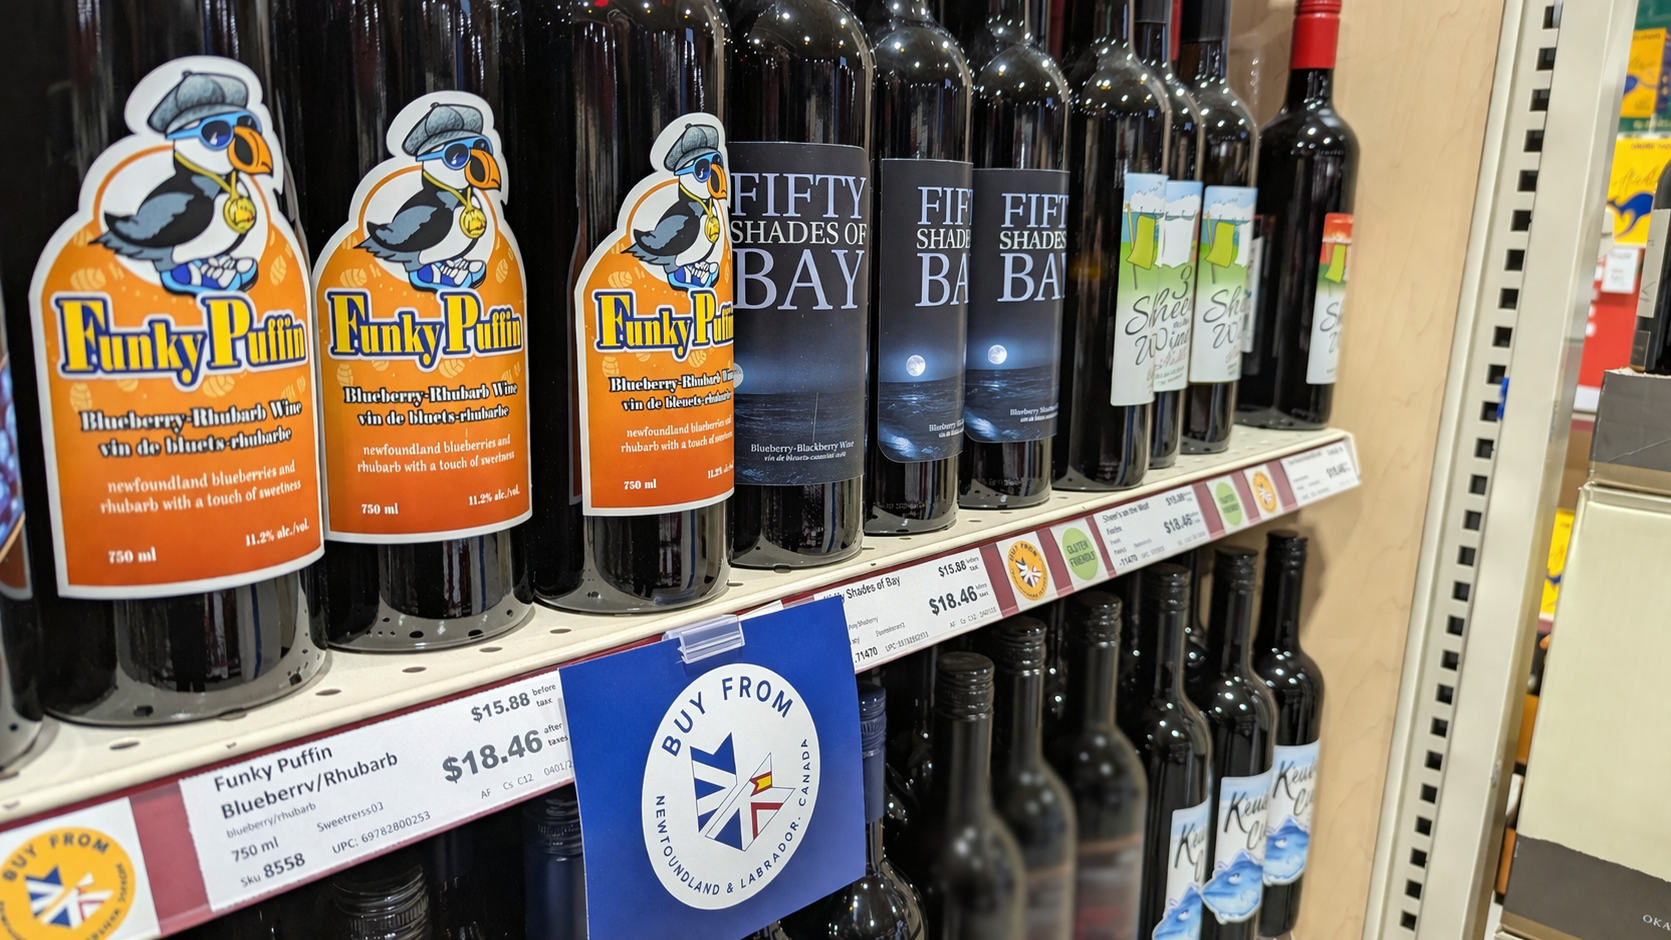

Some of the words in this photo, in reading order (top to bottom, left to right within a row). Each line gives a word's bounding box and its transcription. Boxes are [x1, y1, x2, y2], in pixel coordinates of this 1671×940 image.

[730, 172, 867, 219] FIFTY
[729, 220, 839, 246] SHADES
[844, 221, 868, 246] OF
[999, 230, 1067, 250] SHADES
[732, 249, 866, 311] BAY
[328, 291, 444, 369] Funky
[439, 292, 522, 354] Puffin
[595, 292, 693, 358] Funky
[55, 297, 207, 384] Funky
[199, 295, 306, 370] Puffin
[343, 383, 490, 408] Blueberry-Rhubarb
[491, 380, 518, 397] Wine
[609, 373, 721, 393] Blueberry-Rhubarb
[79, 403, 267, 435] Blueberry-Rhubarb
[268, 398, 303, 420] Wine
[621, 398, 644, 411] vin
[646, 397, 663, 411] de
[357, 410, 383, 426] vin
[386, 410, 405, 426] de
[626, 423, 689, 438] newfoundland
[98, 437, 131, 457] vin
[136, 438, 161, 456] de
[363, 442, 441, 456] newfoundland
[443, 437, 496, 453] blueberries
[497, 433, 511, 446] and
[621, 441, 659, 453] rhubarb
[661, 439, 679, 451] with
[681, 441, 687, 449] a
[688, 435, 707, 448] touch
[107, 473, 208, 493] newfoundland
[211, 466, 277, 486] blueberries
[279, 459, 296, 475] and
[357, 460, 401, 473] rhubarb
[404, 460, 427, 472] with
[430, 462, 437, 471] a
[439, 456, 467, 470] touch
[470, 455, 479, 467] of
[100, 497, 159, 514] rhubarb
[162, 495, 191, 511] with
[195, 497, 204, 508] a
[207, 489, 243, 506] touch
[245, 486, 258, 501] of
[259, 480, 302, 499] sweetness
[624, 480, 642, 490] 750
[644, 478, 657, 489] ml
[361, 504, 381, 515] 750
[384, 503, 399, 515] ml
[468, 493, 492, 506] 11.2%
[245, 530, 275, 547] 11.2%
[277, 517, 310, 540] alc./vol.
[108, 549, 134, 564] 750
[138, 546, 157, 562] ml
[938, 560, 967, 578] $15.88
[846, 583, 876, 599] Shades
[876, 580, 886, 591] of
[886, 575, 901, 589] Bay
[929, 585, 978, 616] $18.46
[471, 692, 531, 723] $15.88
[531, 684, 557, 697] before
[661, 690, 706, 757] BUY
[721, 675, 793, 718] FROM
[442, 729, 543, 784] $18.46
[543, 722, 563, 734] after
[547, 734, 570, 747] taxes
[213, 765, 272, 792] Funky
[277, 746, 333, 773] Puffin
[481, 788, 492, 799] AF
[502, 781, 514, 791] Cs
[517, 773, 534, 786] C12
[226, 802, 317, 839] blueberry/rhubarb
[726, 882, 735, 894] &
[798, 739, 812, 807] CANADA
[332, 838, 359, 854] UPC:
[361, 810, 431, 844] 69782800253
[2, 844, 37, 882] BUY
[49, 832, 110, 855] FROM
[231, 845, 258, 863] 750
[261, 836, 279, 852] ml
[240, 873, 262, 888] Sku
[263, 852, 306, 879] 8558
[1642, 914, 1671, 931] OKA
